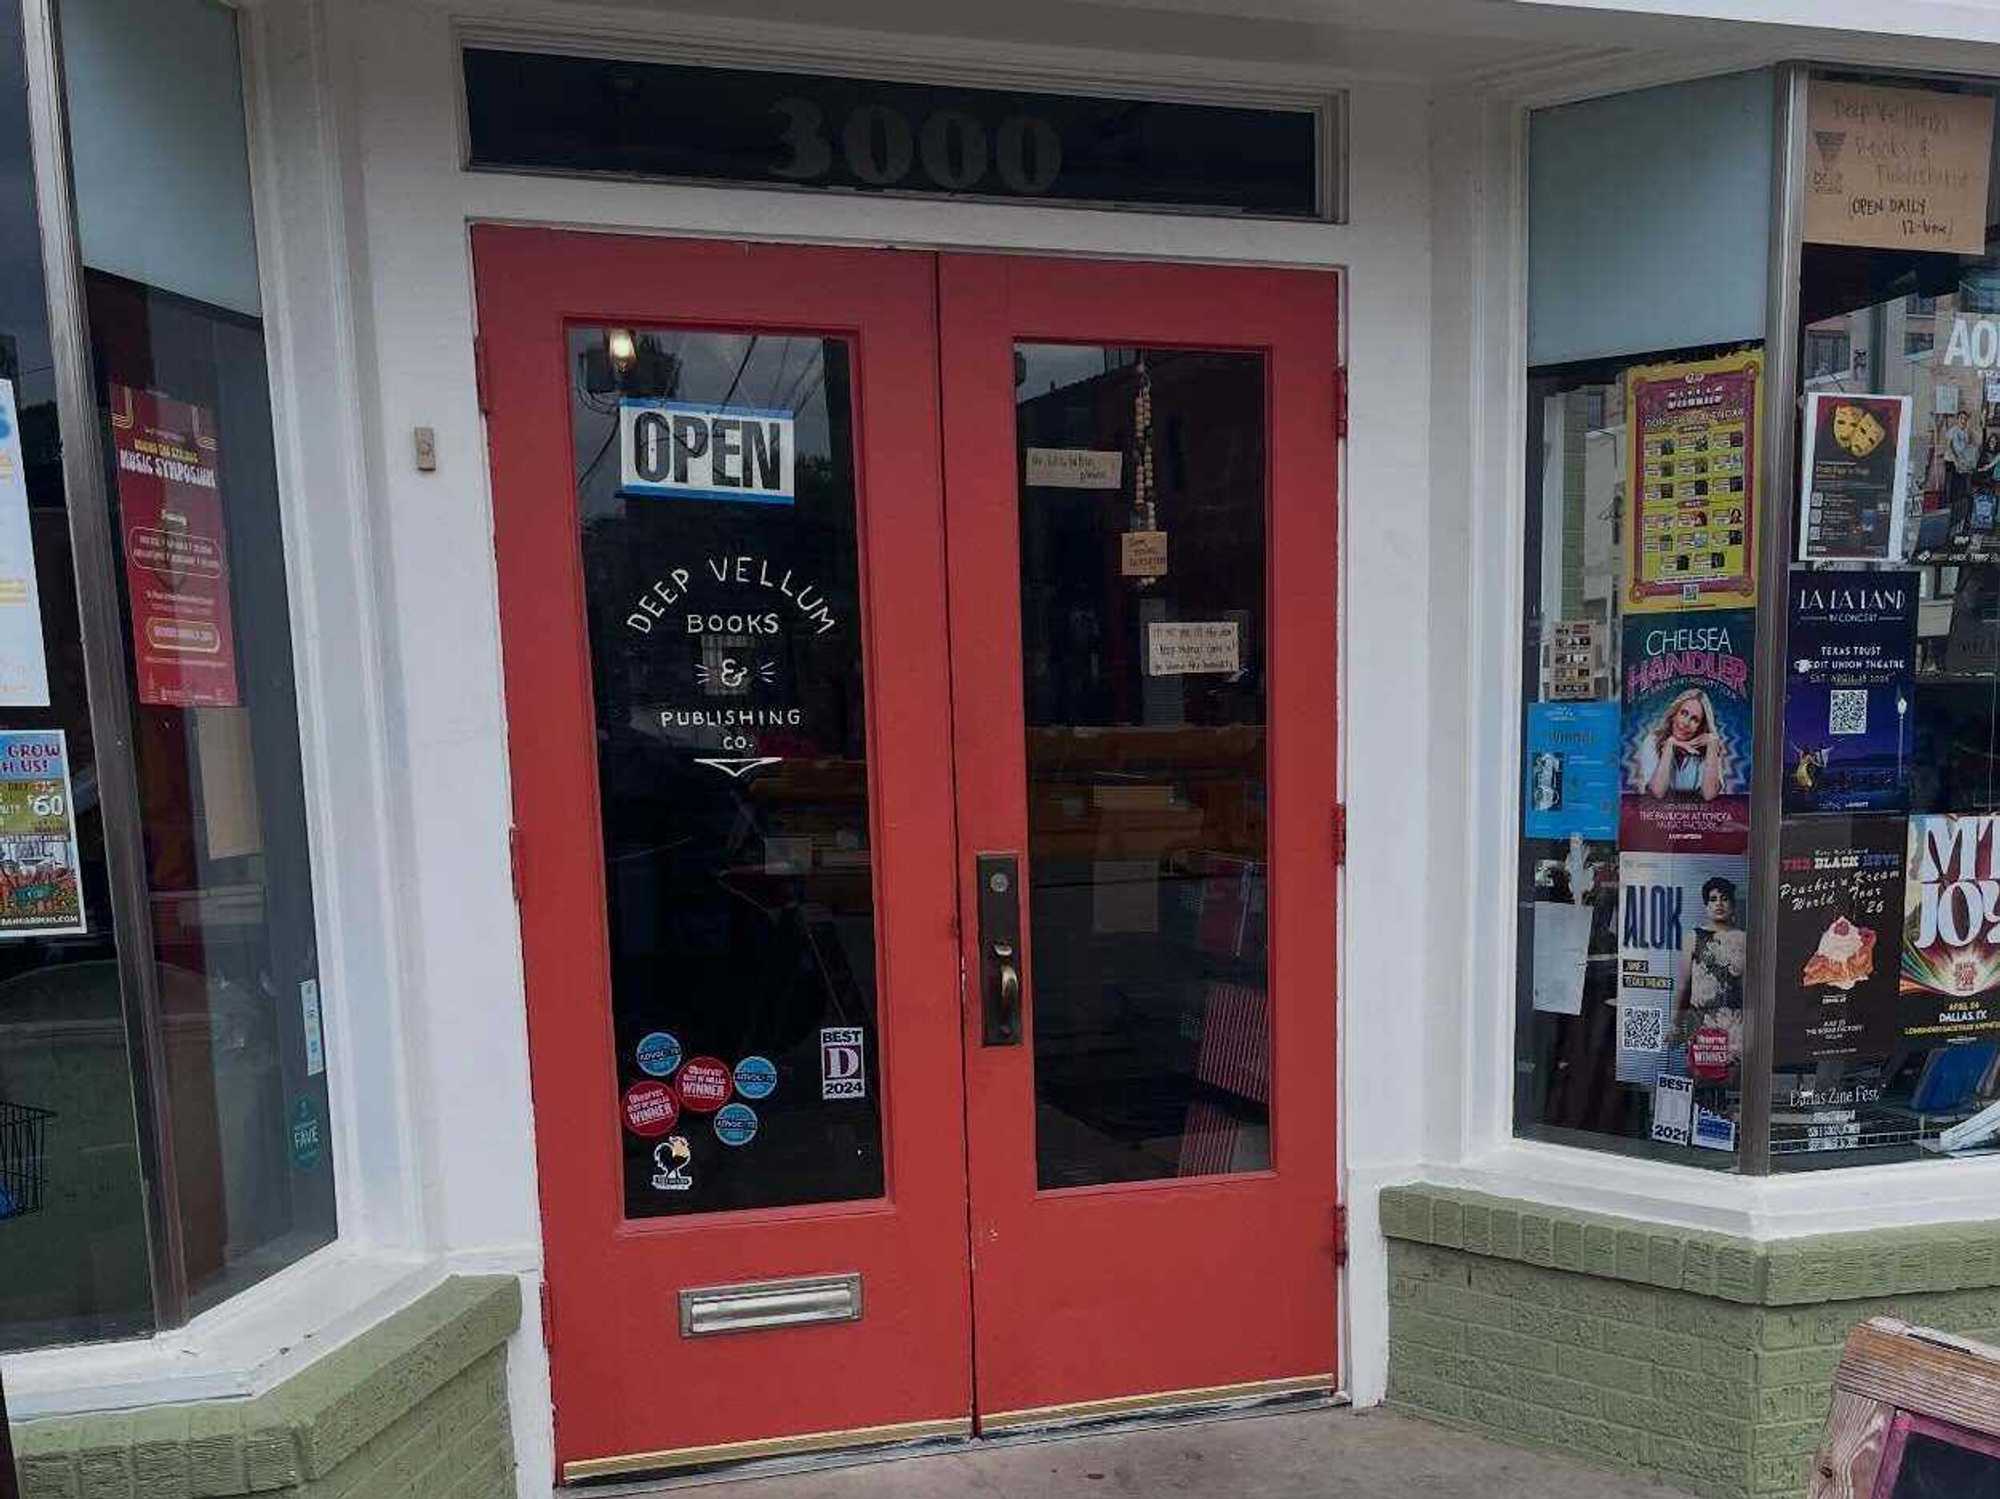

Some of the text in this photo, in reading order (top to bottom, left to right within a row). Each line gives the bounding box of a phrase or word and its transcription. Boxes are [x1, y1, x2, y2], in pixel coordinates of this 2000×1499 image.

[767, 99, 1062, 191] 3000
[1944, 319, 2000, 369] AO
[633, 411, 781, 490] OPEN
[626, 556, 835, 634] DEEP VELLUM
[687, 613, 780, 634] BOOKS
[1646, 627, 1732, 656] CHELSEA
[1821, 646, 1881, 656] TEXAS TRUST
[721, 658, 748, 687] &
[1831, 660, 1862, 669] UNION
[1627, 650, 1747, 703] HANDLER
[661, 708, 801, 727] PUBLISHING
[8, 744, 60, 758] GROW
[723, 736, 752, 750] CO.
[21, 760, 48, 772] US!
[1815, 856, 1859, 870] BLACK
[1623, 885, 1683, 950] ALOK
[822, 1031, 861, 1043] BEST
[826, 1048, 861, 1079] D
[682, 1081, 725, 1097] WINNER
[825, 1082, 863, 1095] 2024
[1658, 1076, 1692, 1092] BEST
[1828, 1087, 1853, 1104] Zine
[1855, 1085, 1880, 1102] Fest
[629, 1105, 674, 1125] WINNER
[294, 1125, 319, 1148] FAVE
[1654, 1124, 1687, 1142] 2021
